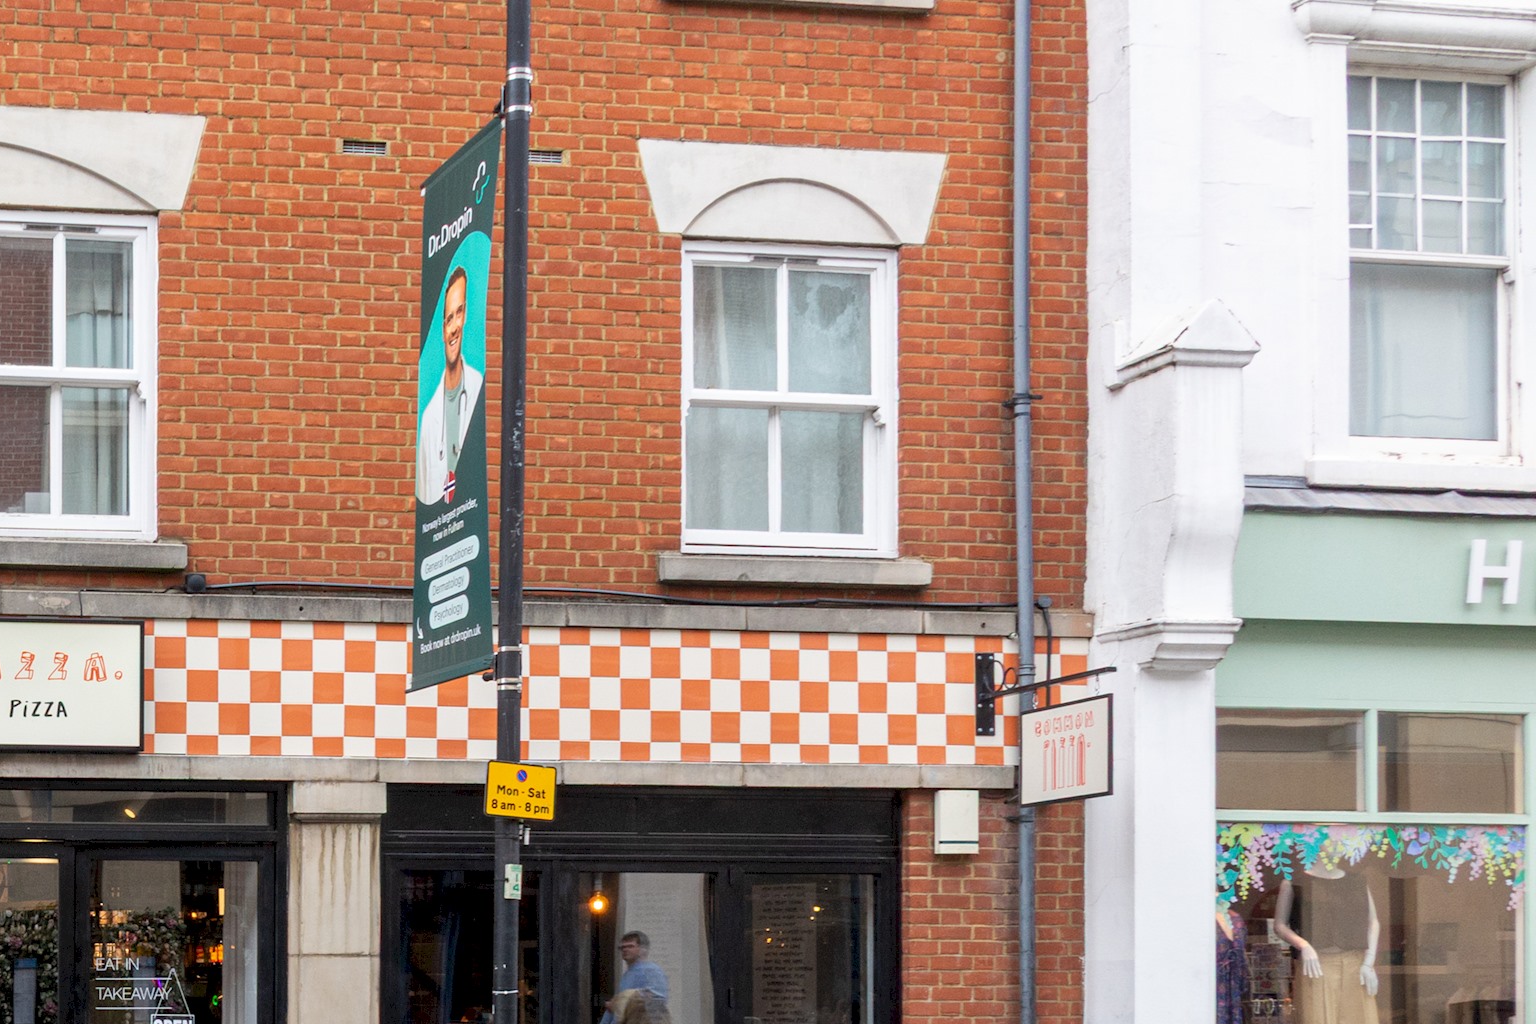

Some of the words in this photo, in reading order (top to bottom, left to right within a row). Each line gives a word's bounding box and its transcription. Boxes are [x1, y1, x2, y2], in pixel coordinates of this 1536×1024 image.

[428, 206, 473, 258] Dr.Dropin
[425, 556, 444, 575] General
[1466, 539, 1523, 604] H
[432, 574, 464, 597] Dermatology
[433, 603, 464, 622] Psychology
[420, 640, 433, 654] Book
[433, 638, 444, 649] now
[1034, 711, 1094, 737] COMMON
[496, 784, 519, 796] Mon
[528, 787, 546, 799] Sat
[491, 799, 498, 809] 8
[500, 803, 516, 811] am
[524, 802, 531, 812] 8
[533, 805, 550, 815] pm
[95, 957, 121, 971] EAT
[125, 957, 140, 971] IN
[95, 987, 172, 1001] TAKEAWAY
